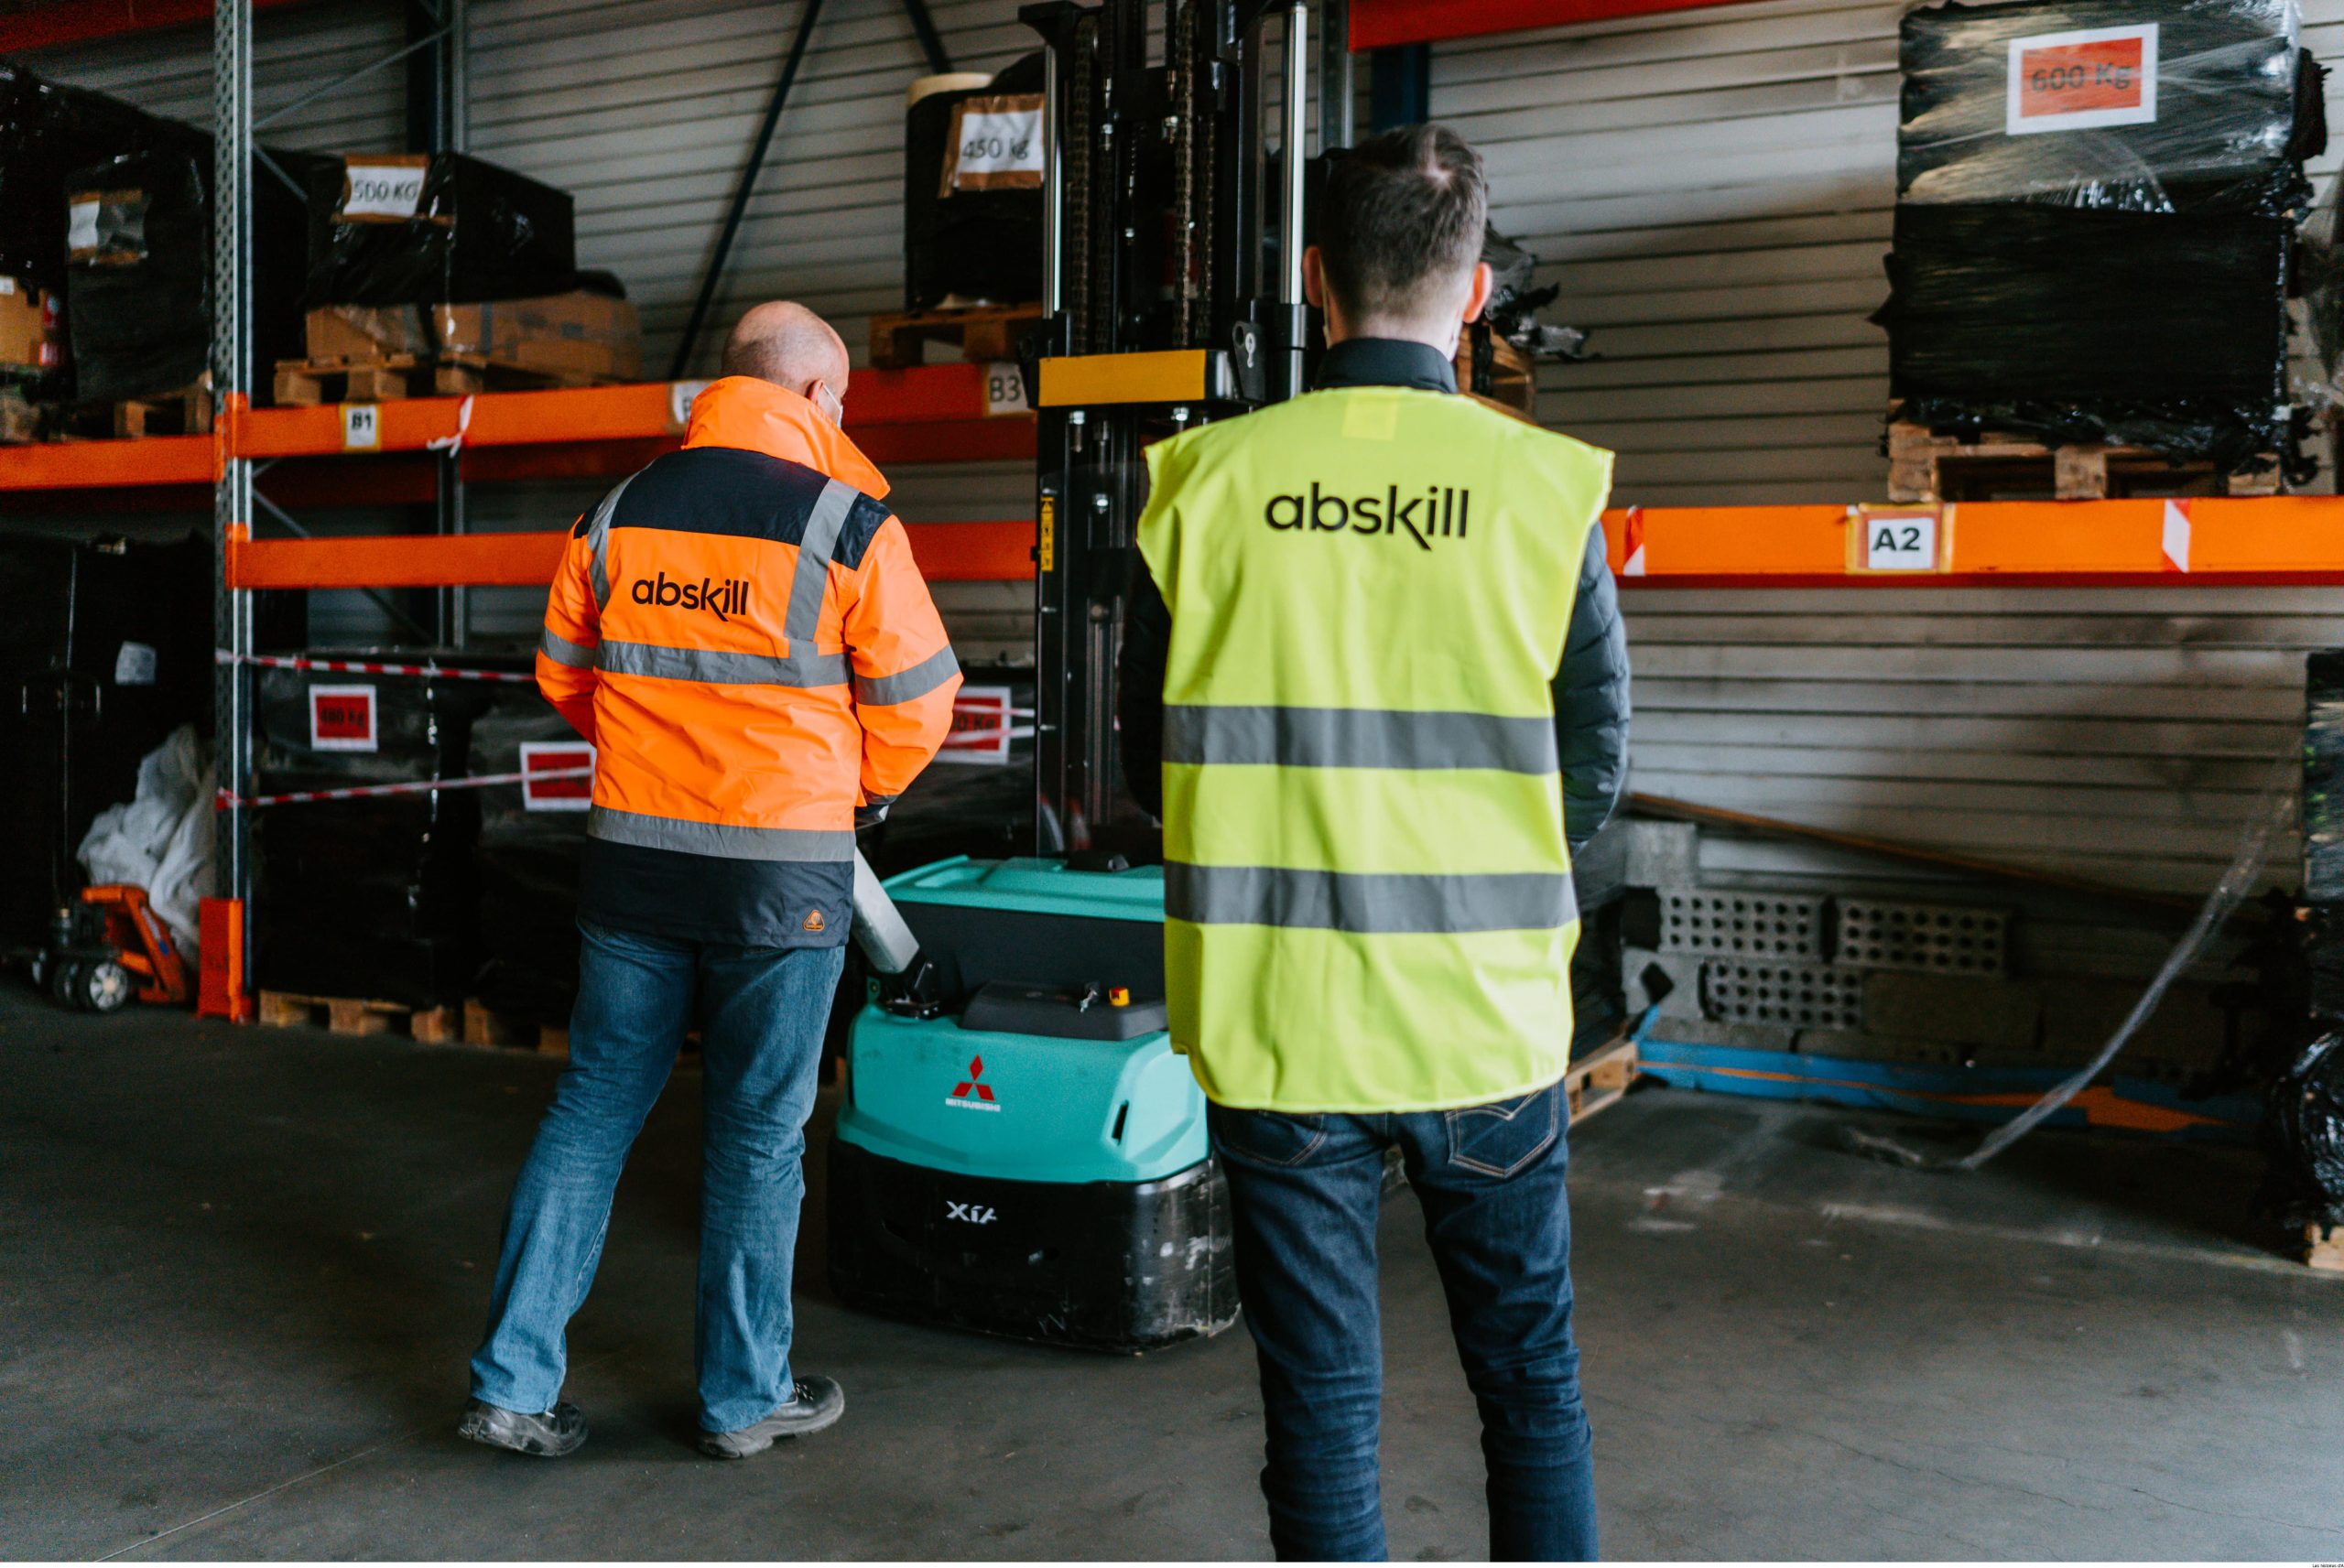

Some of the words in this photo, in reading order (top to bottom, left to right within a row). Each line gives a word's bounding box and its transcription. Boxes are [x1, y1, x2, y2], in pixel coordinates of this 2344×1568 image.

[2032, 65, 2085, 92] 600
[2095, 62, 2132, 90] Kg
[962, 138, 1004, 159] 450
[353, 179, 389, 201] 500
[393, 180, 420, 201] KG
[991, 375, 1021, 402] B3
[352, 410, 372, 430] B1
[1265, 481, 1470, 551] abskill
[1872, 526, 1920, 551] A2
[632, 571, 749, 622] abskill
[945, 1098, 1002, 1113] MITSUBISHI
